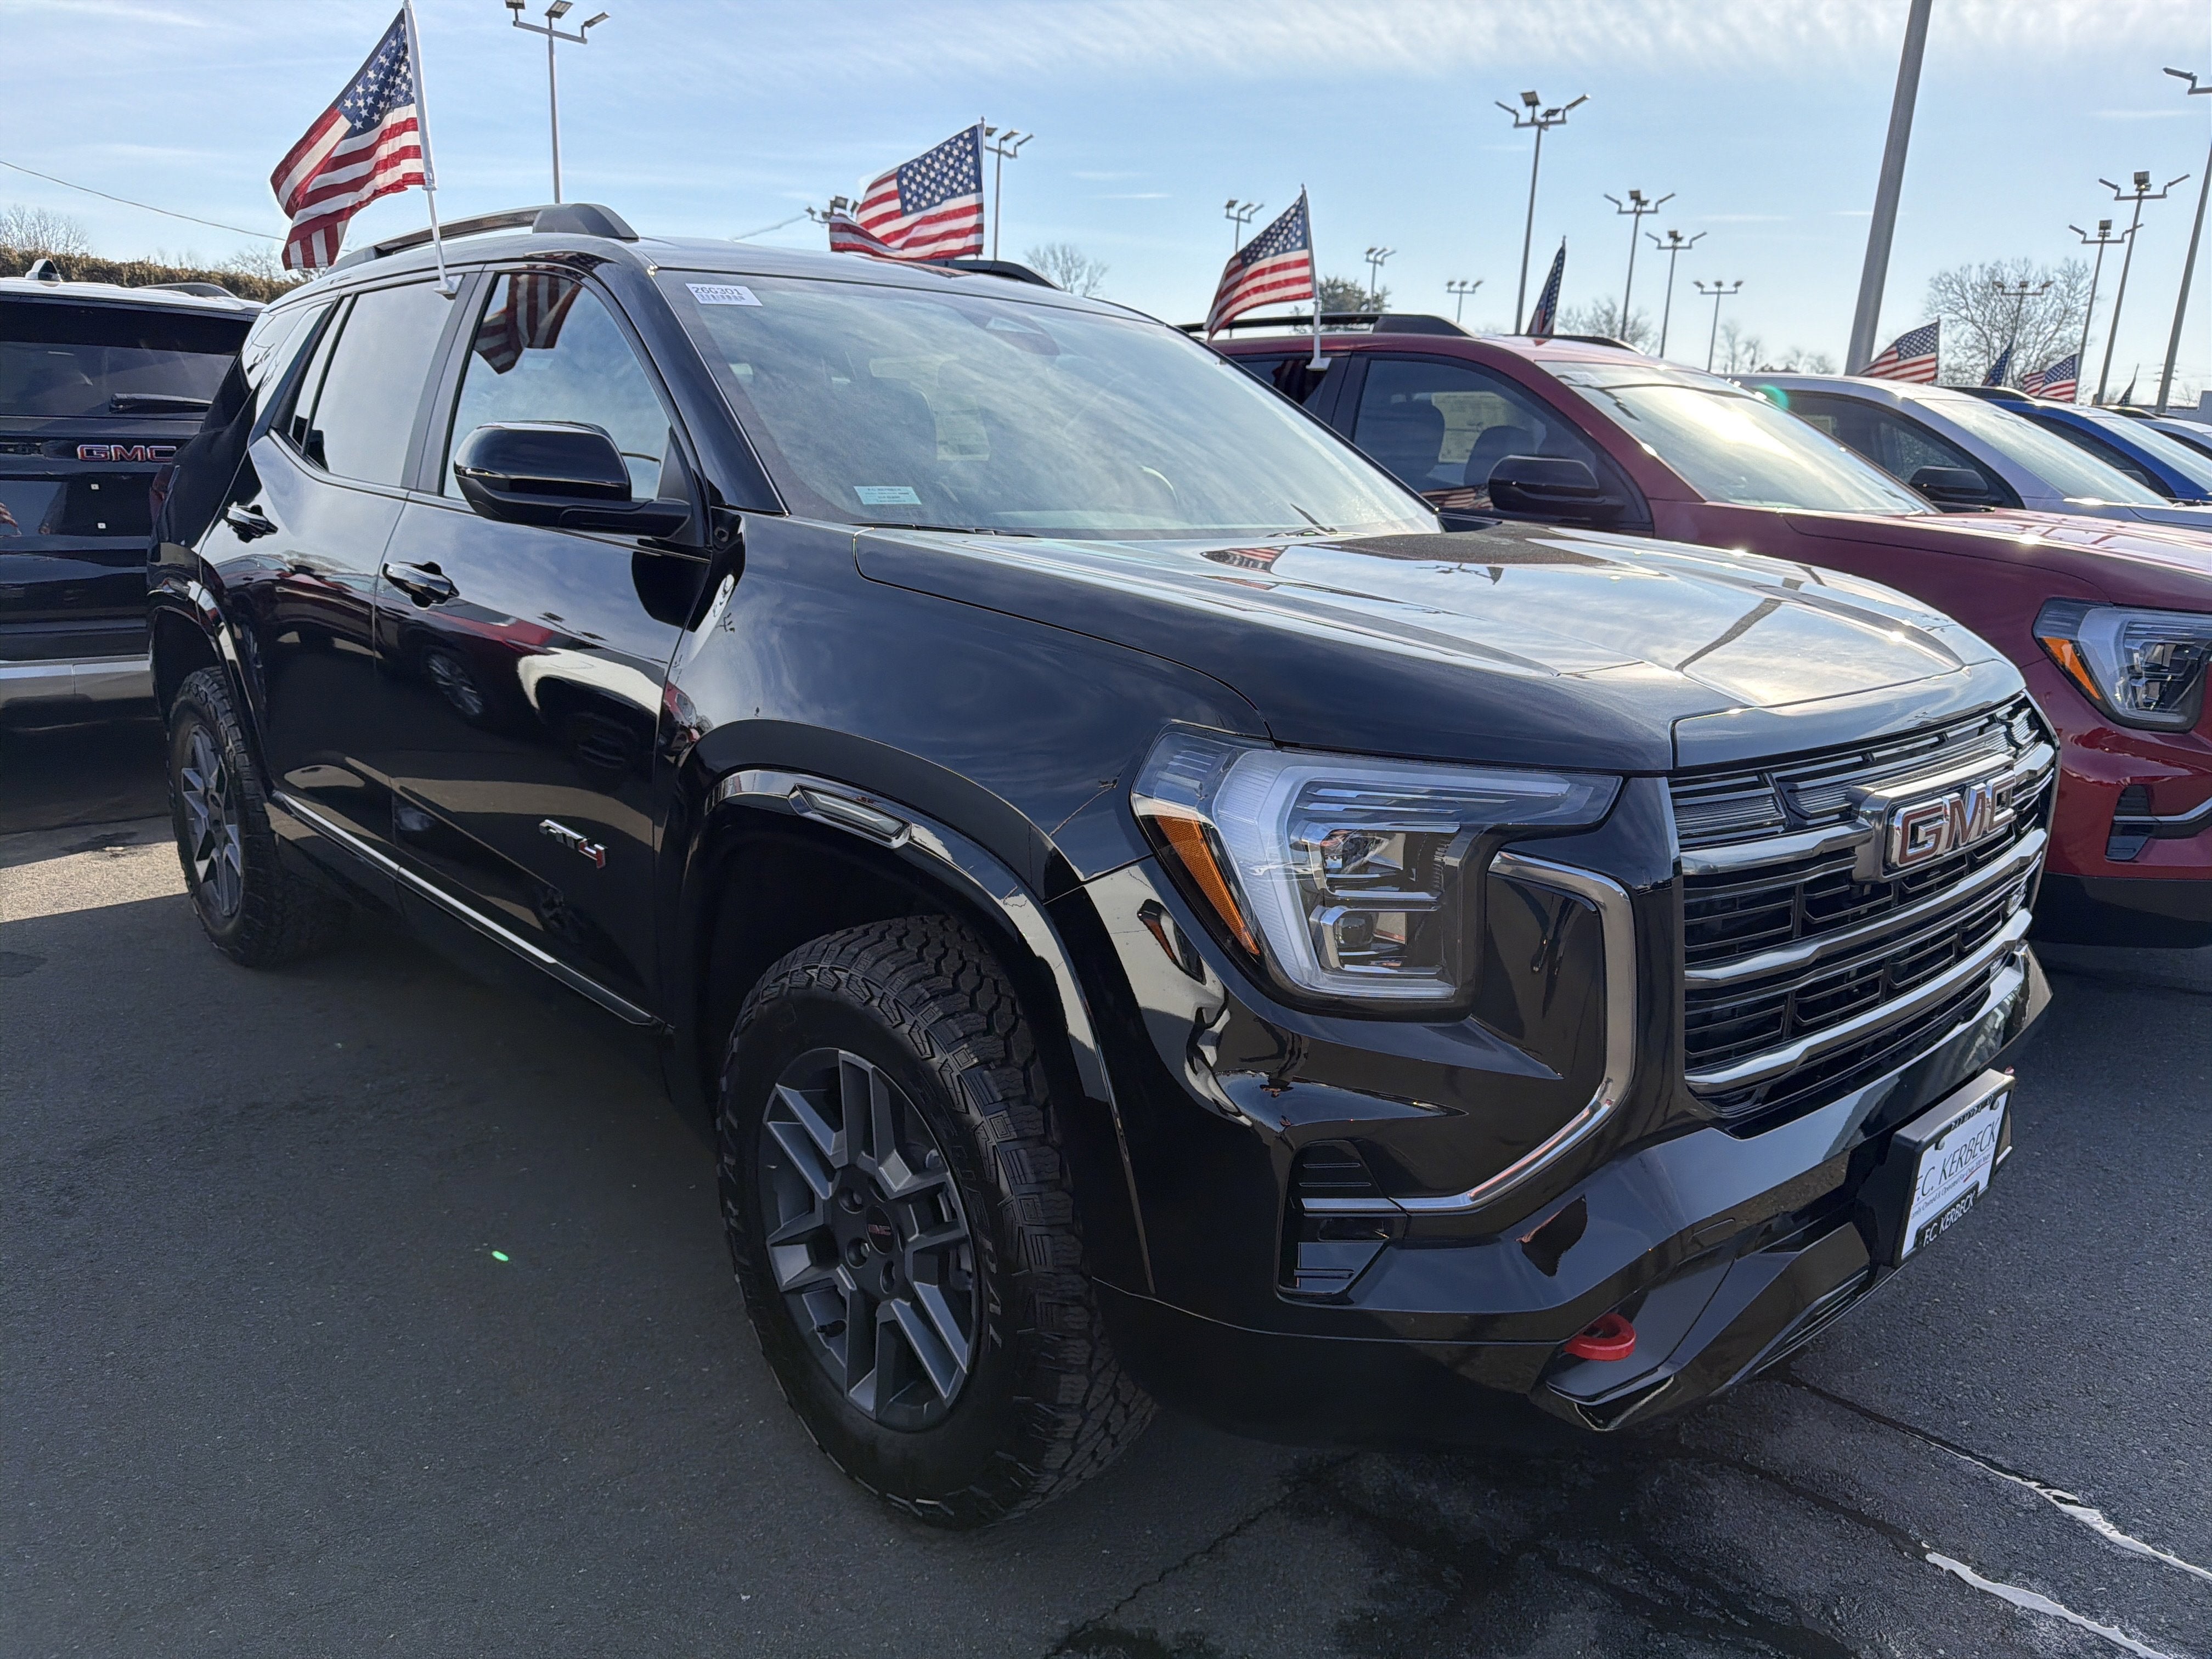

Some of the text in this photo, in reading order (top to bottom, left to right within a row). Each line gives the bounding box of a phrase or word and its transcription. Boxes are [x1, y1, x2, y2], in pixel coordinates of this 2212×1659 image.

[691, 286, 743, 295] 26G301
[77, 444, 177, 462] GMC
[1891, 770, 2017, 867] GMC
[1939, 1117, 2000, 1185] KERBECK
[1939, 1190, 1976, 1234] KERBECK
